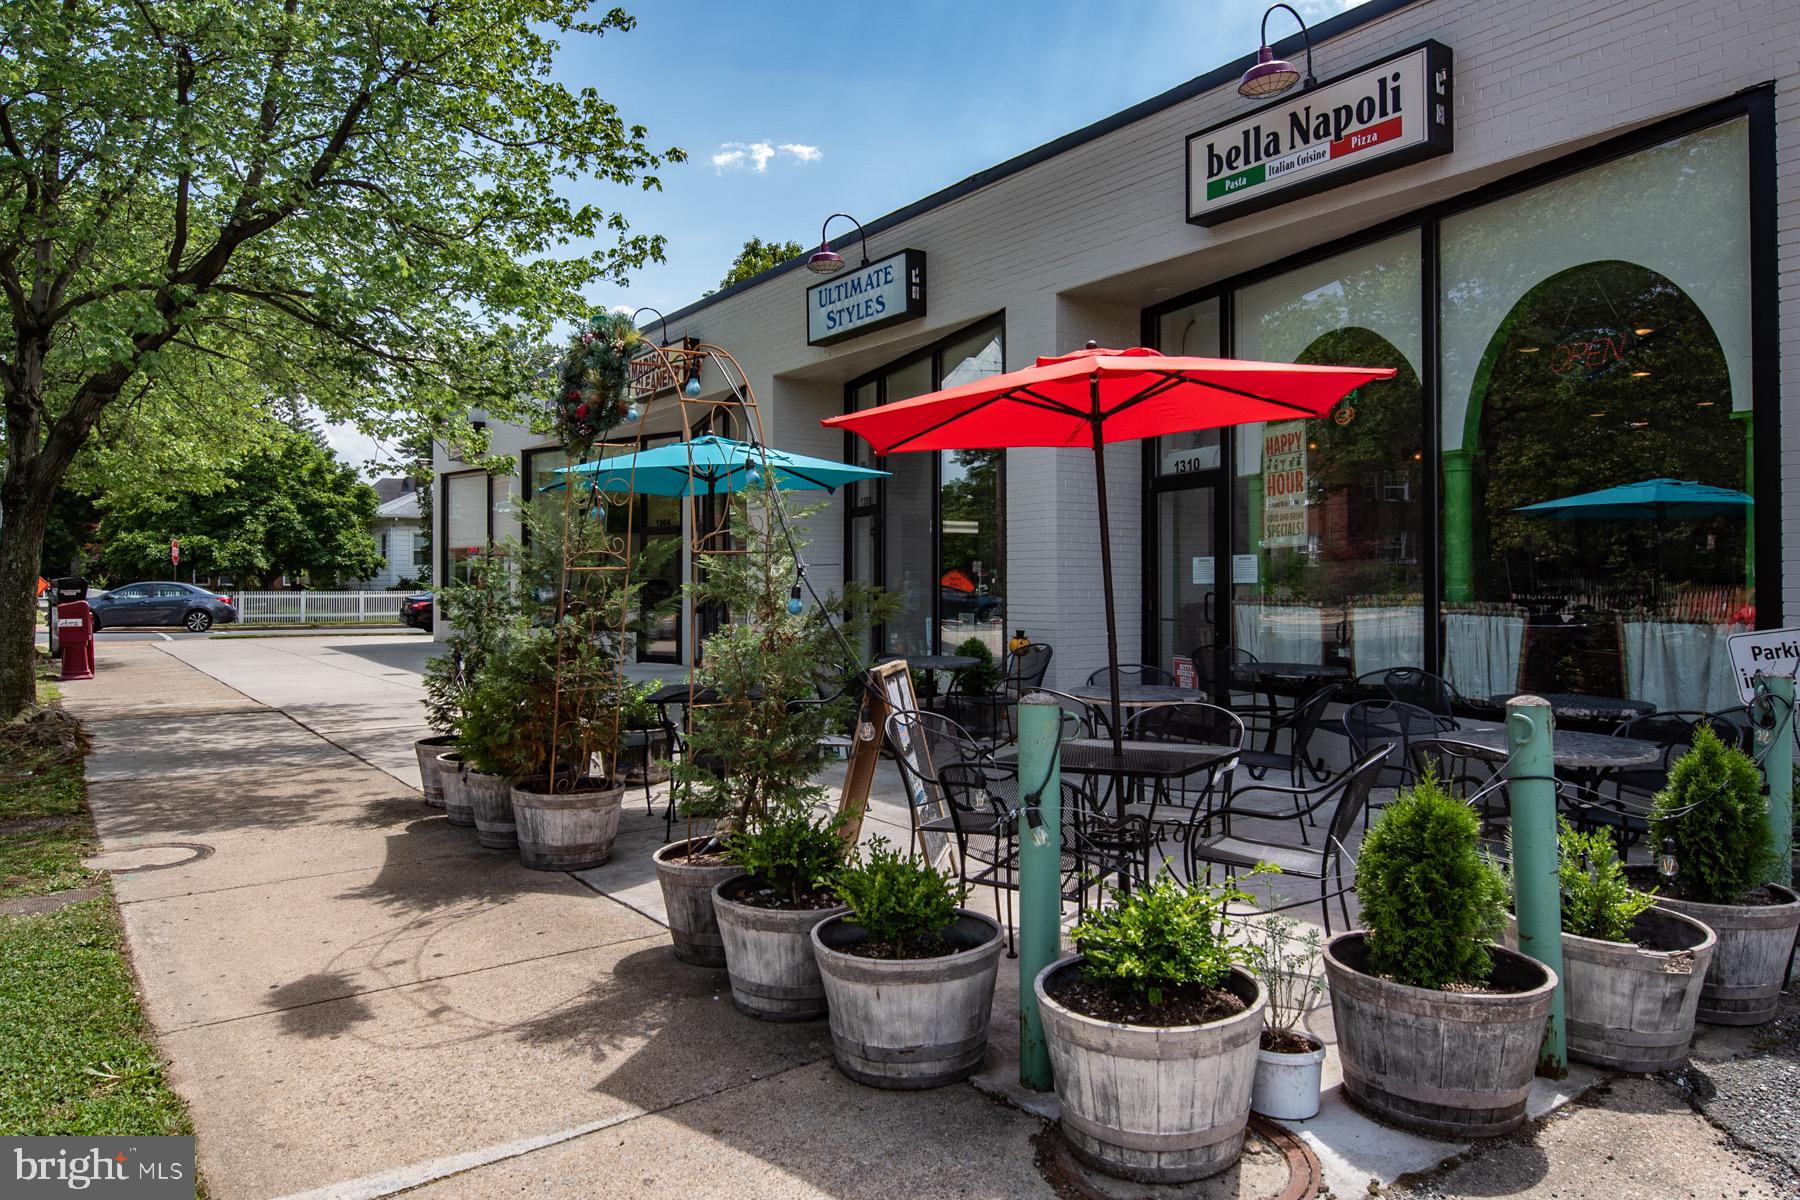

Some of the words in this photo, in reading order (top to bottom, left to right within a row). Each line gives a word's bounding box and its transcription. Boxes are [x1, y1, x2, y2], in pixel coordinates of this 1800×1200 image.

[1207, 125, 1281, 180] bella
[1289, 72, 1402, 150] Napoli
[1351, 131, 1378, 149] Pizza
[1268, 158, 1295, 177] Italian
[1297, 149, 1327, 168] Cuisine
[1225, 175, 1247, 192] Pasta
[818, 264, 894, 309] ULTIMATE
[826, 295, 886, 331] STYLES
[1551, 332, 1629, 374] OPEN
[1266, 431, 1302, 456] HAPPY
[1174, 457, 1200, 473] 1310
[1267, 471, 1304, 497] HOUR
[1267, 521, 1304, 538] SPECIALS!
